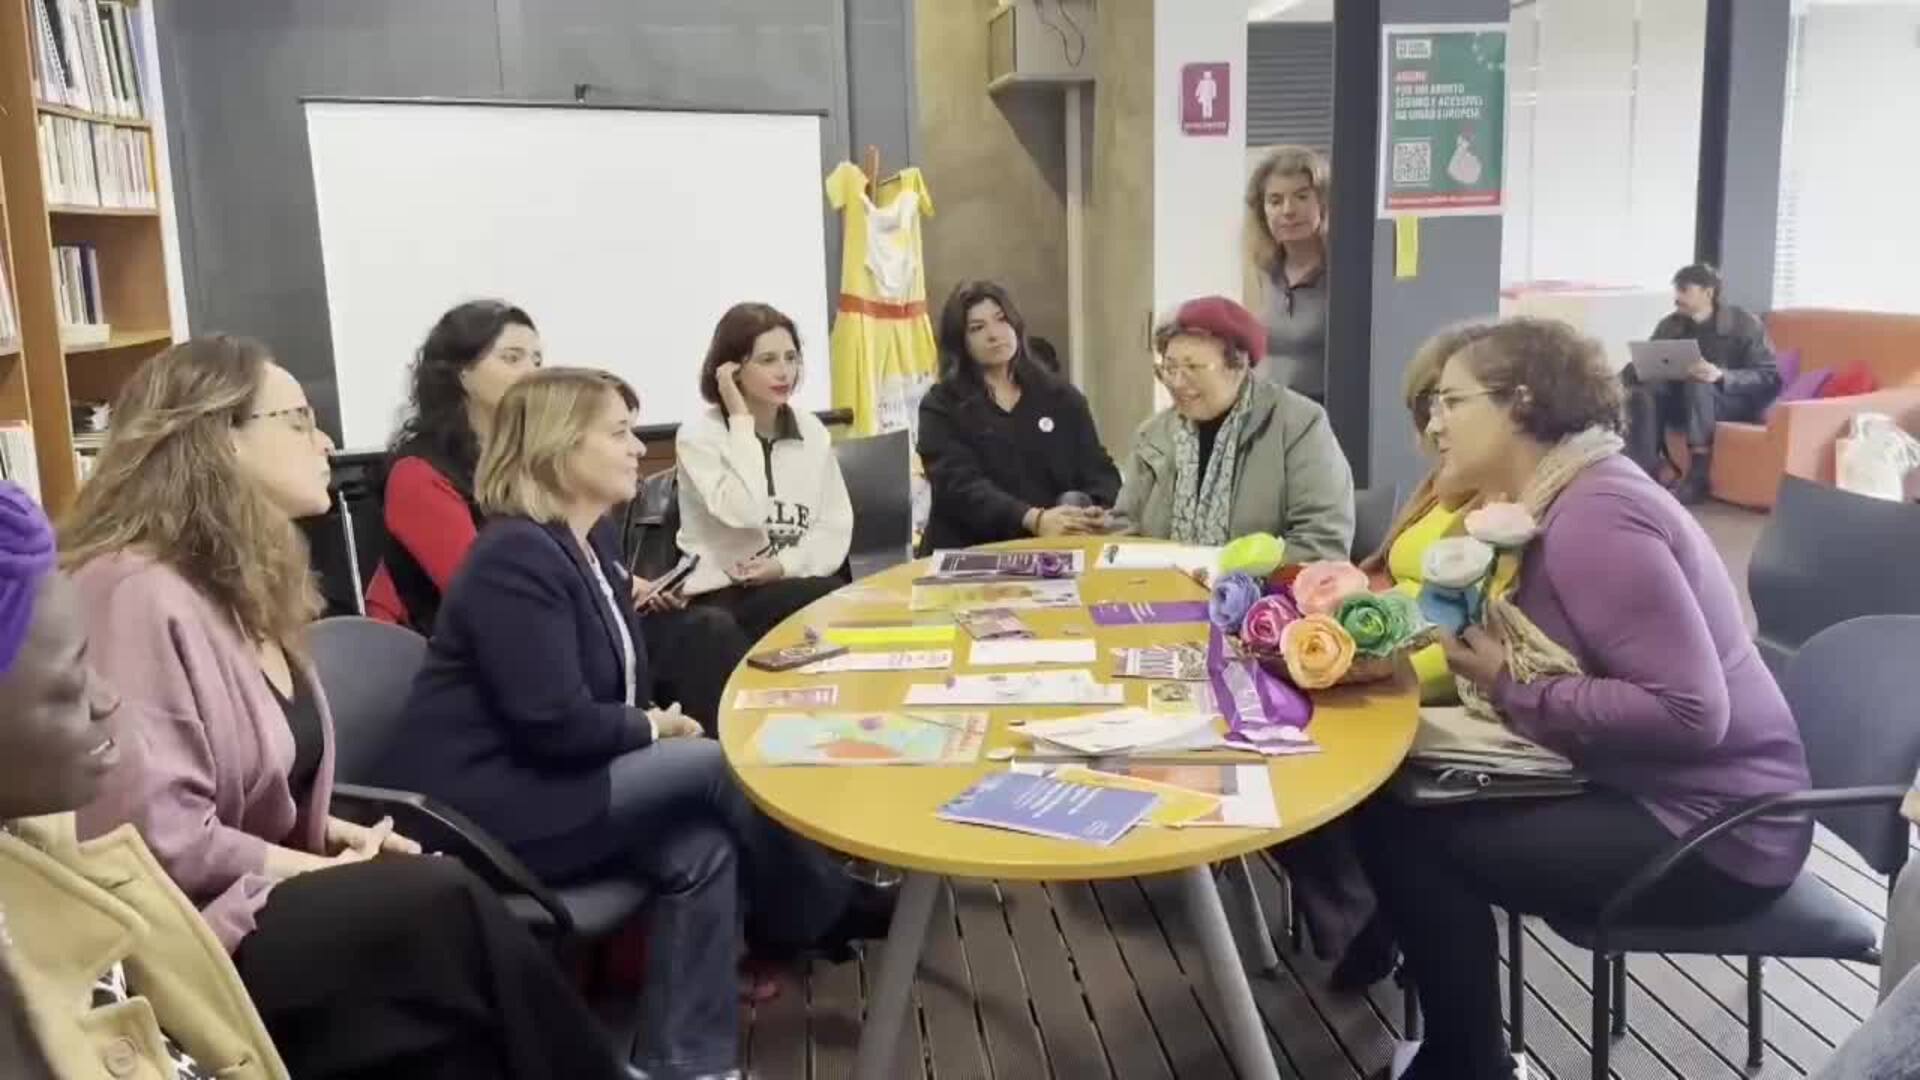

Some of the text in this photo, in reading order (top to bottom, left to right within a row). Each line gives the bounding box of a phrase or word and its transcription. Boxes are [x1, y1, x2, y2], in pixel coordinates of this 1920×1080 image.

[1396, 83, 1464, 95] POR UM ABORTO
[1396, 96, 1430, 108] SEGURO
[766, 500, 809, 529] LE
